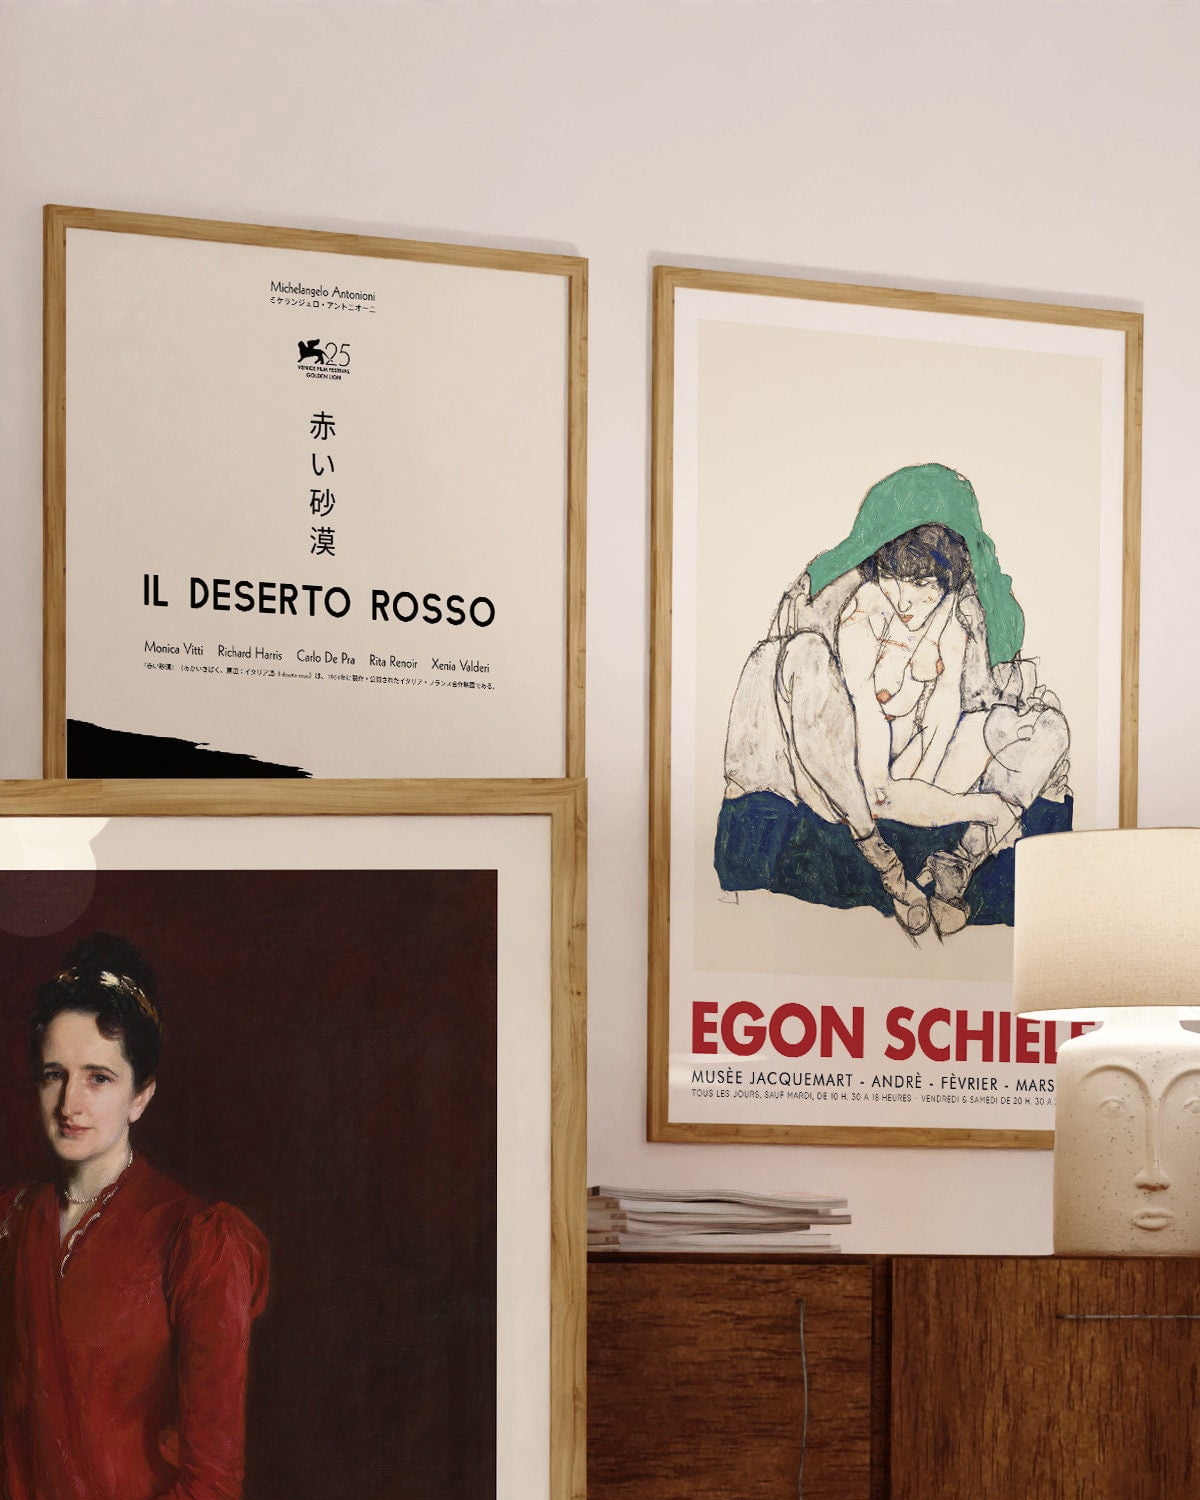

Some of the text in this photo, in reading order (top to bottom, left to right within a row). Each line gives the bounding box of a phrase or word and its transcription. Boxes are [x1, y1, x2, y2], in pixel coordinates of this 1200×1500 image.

[270, 280, 376, 302] Michelangelo Antonioni
[325, 342, 351, 367] 25
[309, 410, 336, 557] 赤い砂漠
[143, 573, 496, 627] IL DESERTO ROSSO
[144, 640, 490, 673] Monica Vitti Richard Harris Carlo De Pra Rita Renoir Xenia Valderi
[691, 1000, 1095, 1064] EGON SCHIEL
[691, 1066, 743, 1085] MUSÈE
[749, 1071, 853, 1087] JACQUEMART
[871, 1072, 922, 1089] ANDRÈ
[941, 1073, 998, 1091] FÈVRIER
[1016, 1079, 1055, 1092] MARS
[691, 1088, 714, 1098] TOUS
[716, 1089, 730, 1098] LES
[764, 1090, 784, 1099] SAUF
[816, 1091, 828, 1100] DE
[851, 1093, 862, 1101] 30
[872, 1094, 880, 1102] 18
[881, 1094, 912, 1103] HEURES
[920, 1095, 960, 1104] VENDREDI
[962, 1095, 968, 1104] &
[969, 1096, 999, 1105] SAMEDI
[1000, 1097, 1011, 1105] DE
[1013, 1097, 1023, 1105] 20
[1035, 1098, 1045, 1106] 30
[1046, 1098, 1053, 1106] A
